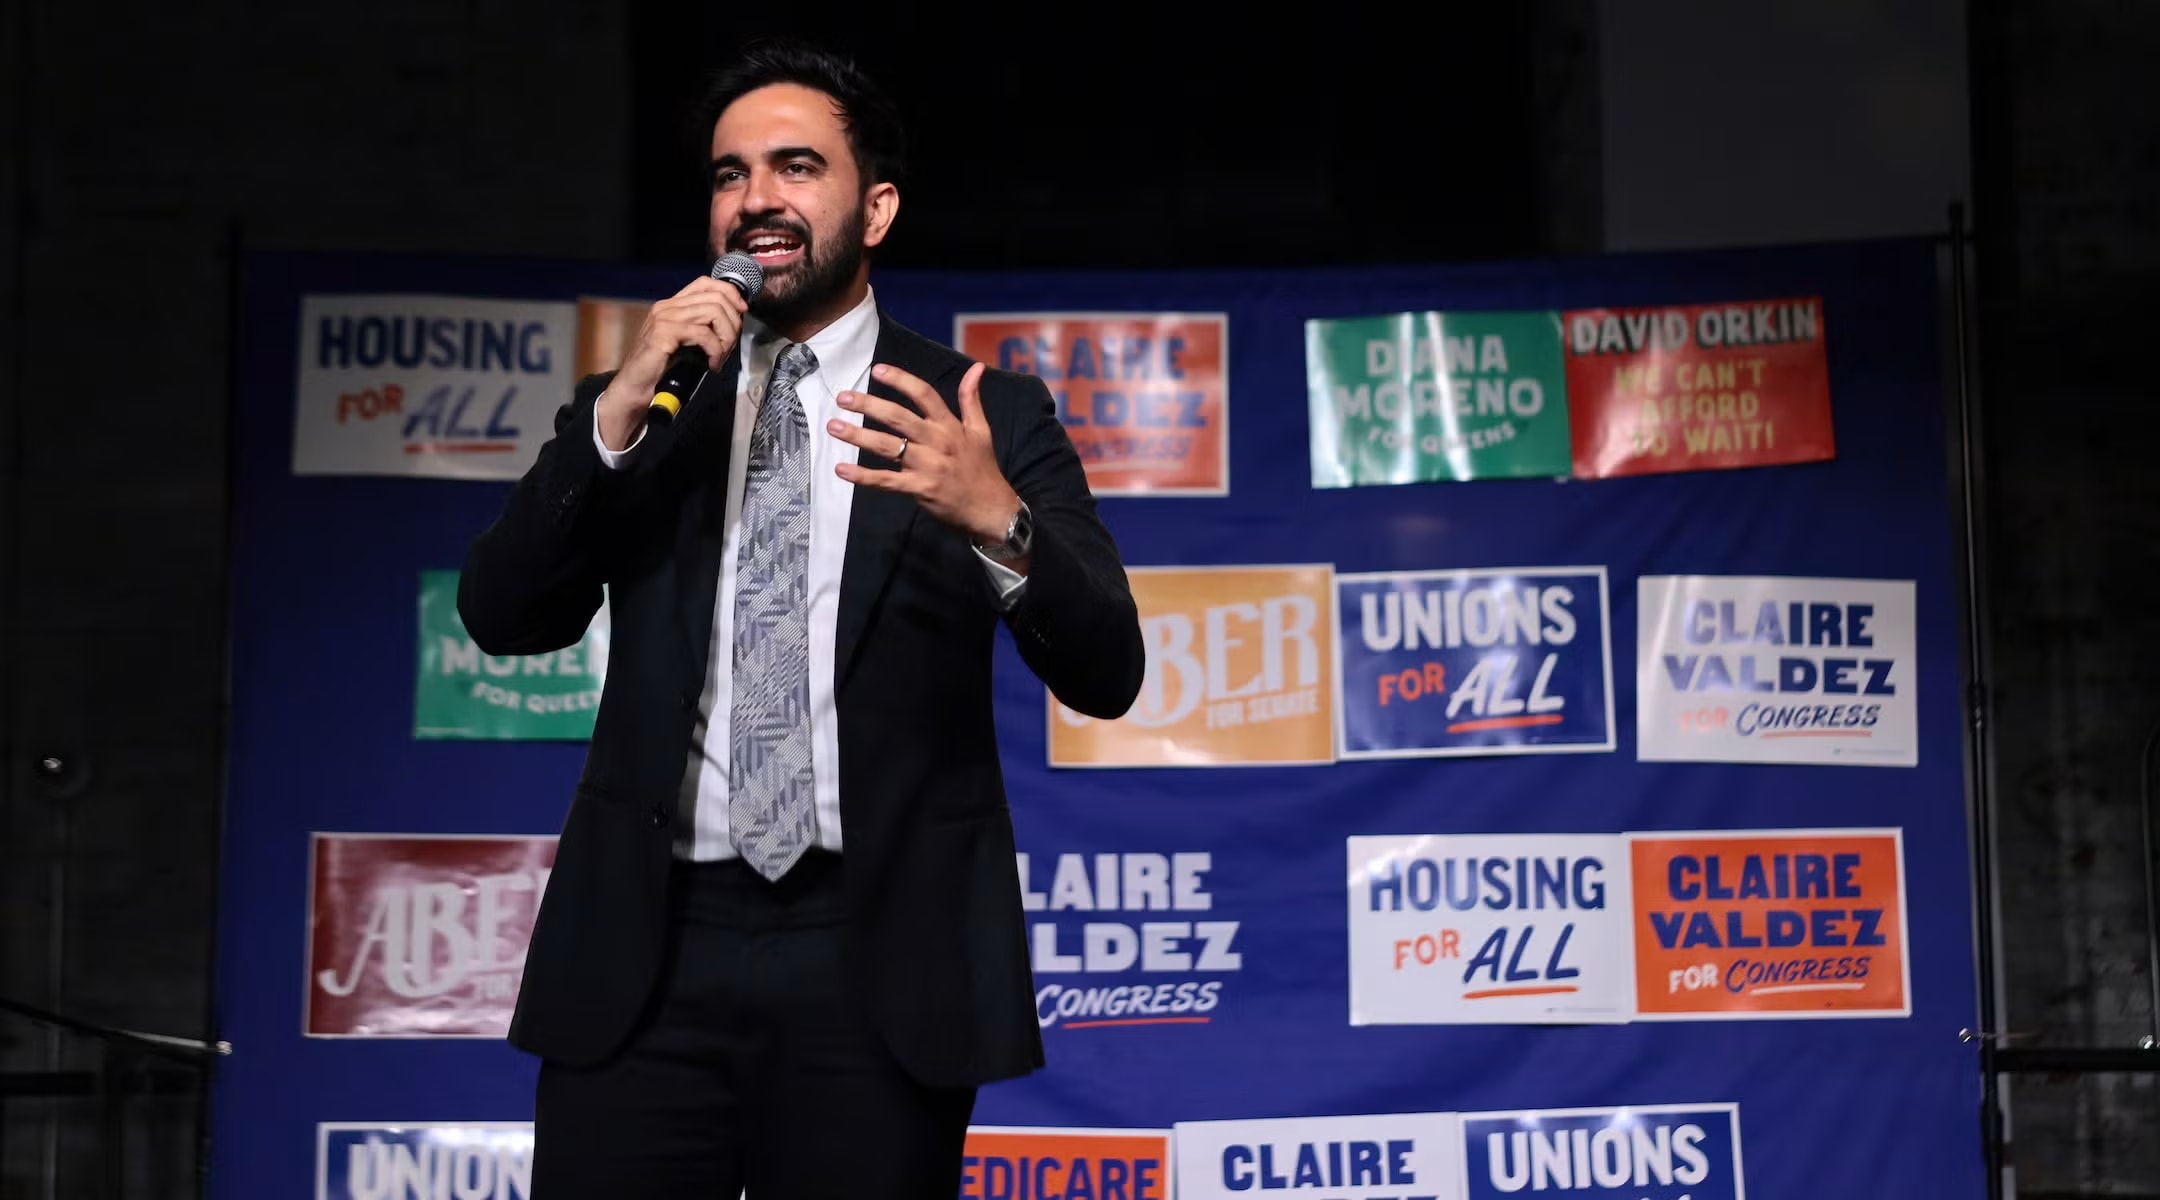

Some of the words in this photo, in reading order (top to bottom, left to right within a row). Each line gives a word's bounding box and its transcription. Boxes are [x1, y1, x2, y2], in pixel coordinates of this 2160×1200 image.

[318, 314, 552, 374] HOUSING
[1572, 310, 1688, 356] DAVID
[1697, 303, 1816, 348] ORKIN
[1366, 334, 1508, 377] DIANA
[1675, 359, 1766, 390] CAN'T
[337, 383, 405, 424] FOR
[404, 384, 521, 439] ALL
[1053, 390, 1208, 428] LDEZ
[1334, 378, 1544, 421] MORENO
[1640, 391, 1760, 422] AFFORD
[1683, 419, 1775, 456] WAIT!
[1360, 585, 1577, 651] UNIONS
[1683, 599, 1874, 648] CLAIRE
[1057, 595, 1319, 727] BER
[1378, 662, 1446, 707] FOR
[1445, 652, 1565, 719] ALL
[1663, 655, 1897, 697] VALDEZ
[472, 681, 521, 709] FOR
[1680, 706, 1729, 734] FOR
[1016, 852, 1212, 911] LAIRE
[1369, 856, 1606, 912] HOUSING
[1668, 853, 1862, 901] CLAIRE
[318, 868, 552, 998] ABE
[1032, 920, 1242, 972] LDEZ
[1394, 929, 1460, 970] FOR
[1463, 922, 1580, 983] ALL
[1650, 909, 1886, 949] VALDEZ
[1669, 964, 1719, 993] FOR
[348, 1142, 535, 1200] UNION
[959, 1155, 1159, 1200] EDICARE
[1222, 1138, 1416, 1191] CLAIRE
[1488, 1123, 1710, 1192] UNIONS
